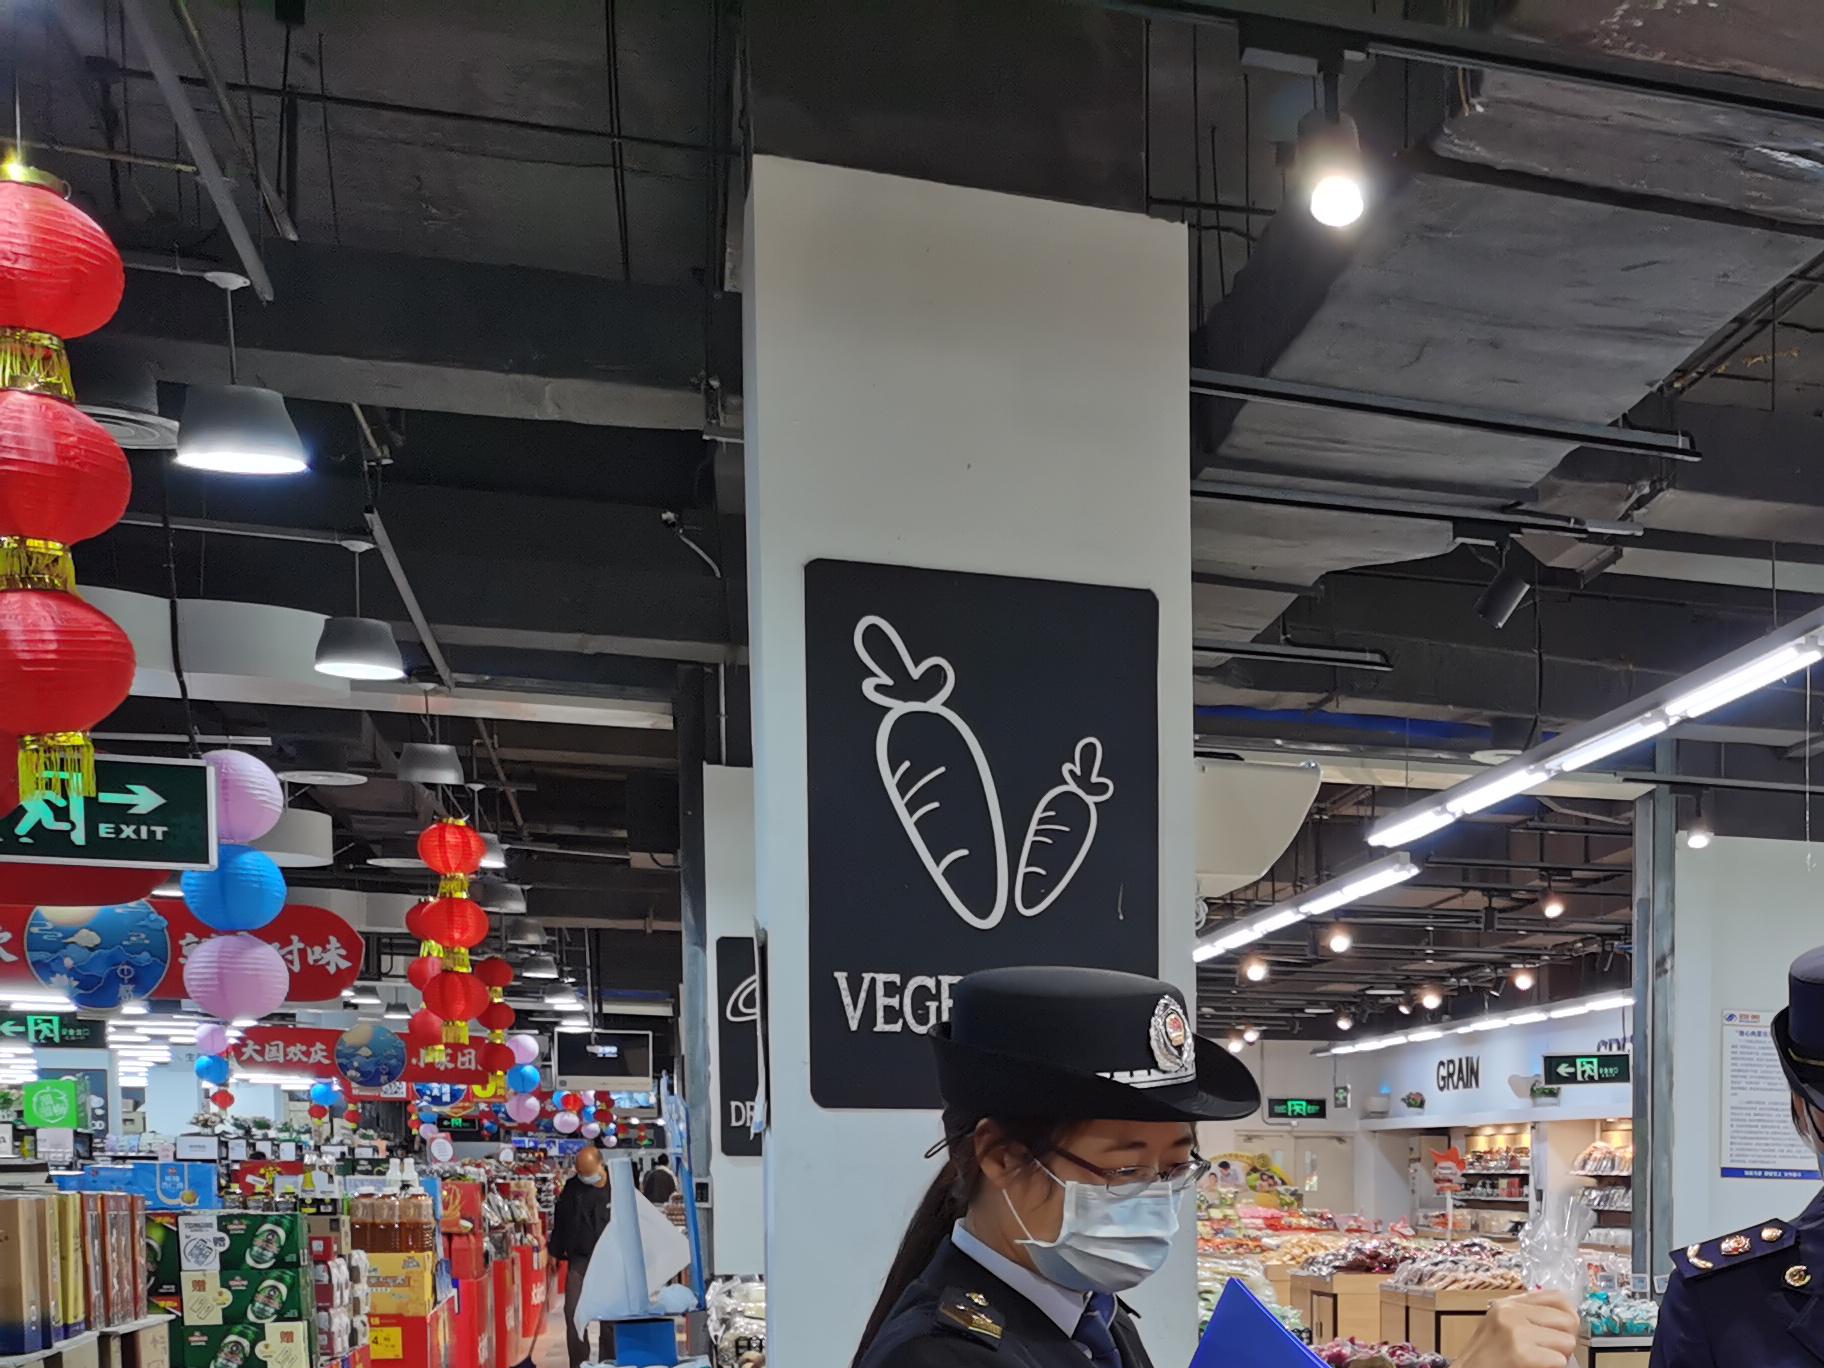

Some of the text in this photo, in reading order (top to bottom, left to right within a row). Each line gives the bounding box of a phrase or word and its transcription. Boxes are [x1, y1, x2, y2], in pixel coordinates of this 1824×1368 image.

[99, 823, 168, 841] EXIT
[241, 1040, 332, 1065] 大国欢庆
[1436, 1056, 1480, 1092] GRAIN
